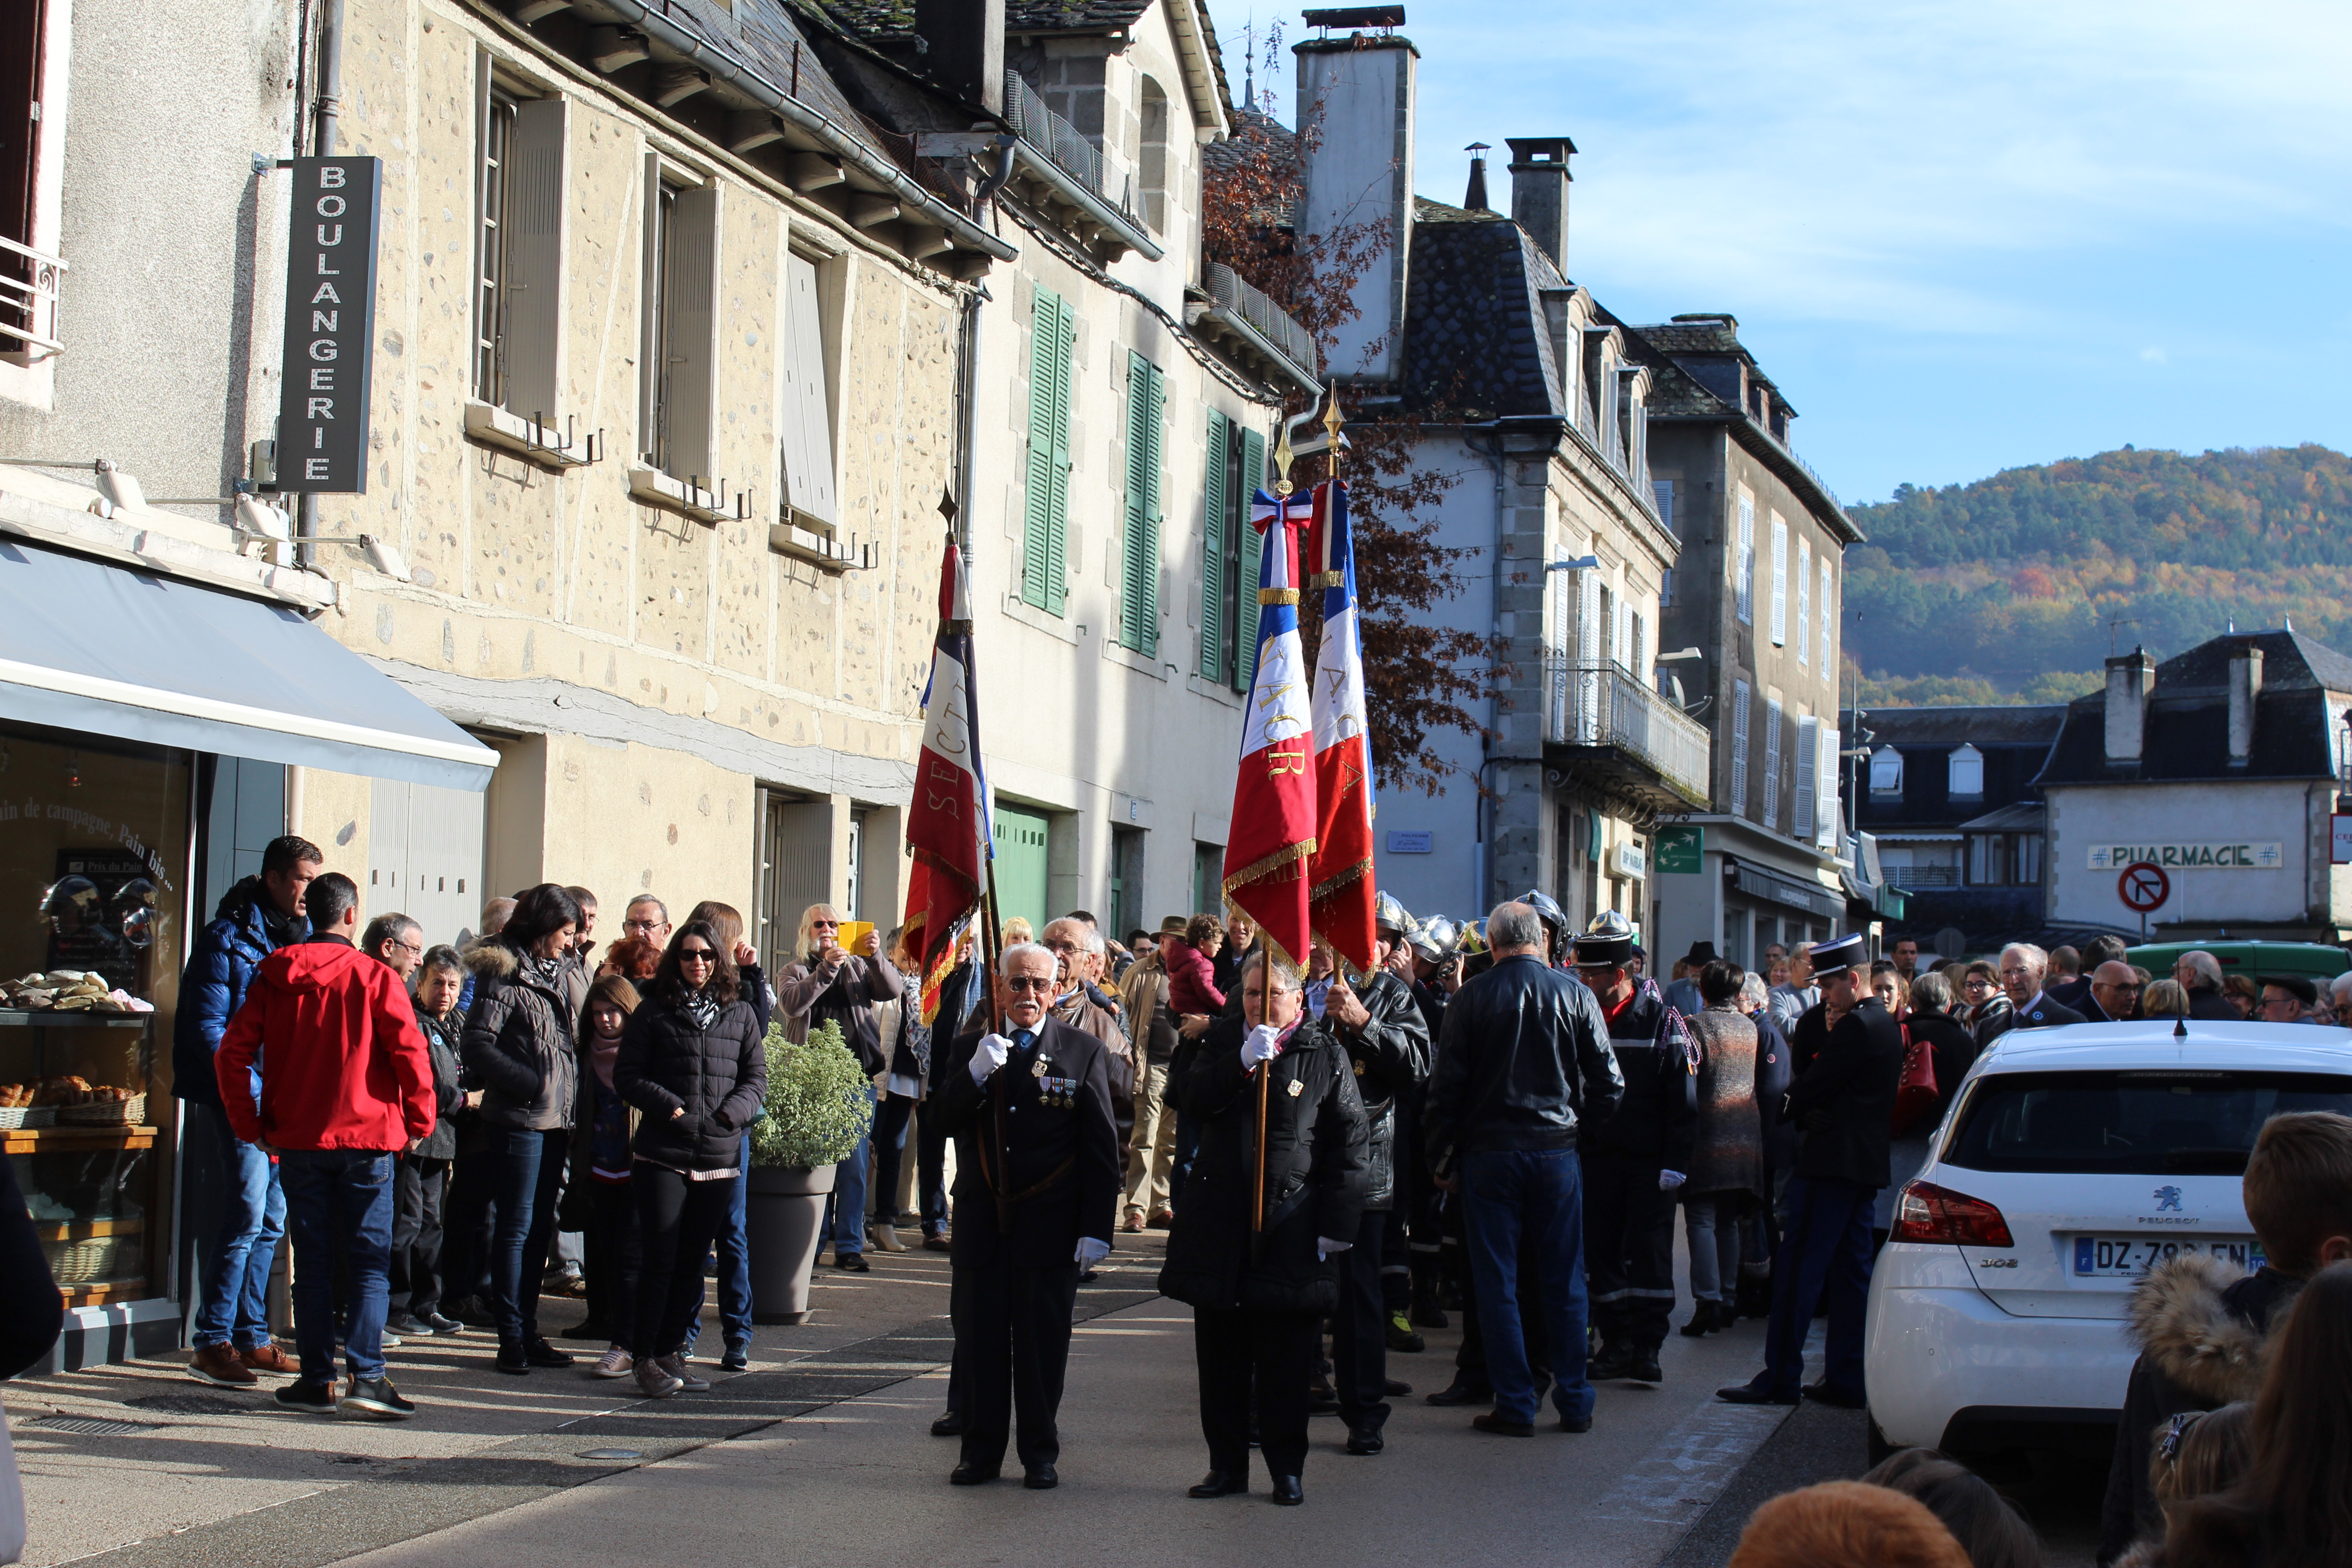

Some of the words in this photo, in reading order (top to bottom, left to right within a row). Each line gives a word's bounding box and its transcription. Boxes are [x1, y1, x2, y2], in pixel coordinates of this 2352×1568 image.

[305, 167, 347, 480] BOULANGERIE
[24, 797, 40, 818] de
[47, 804, 114, 840] campagne,
[118, 823, 145, 860] Pain
[148, 849, 173, 892] bis...
[88, 862, 108, 871] Prix
[108, 862, 120, 871] du
[122, 862, 142, 871] Pain
[2112, 845, 2254, 867] PHARMACIE
[1980, 1258, 2019, 1268] 308
